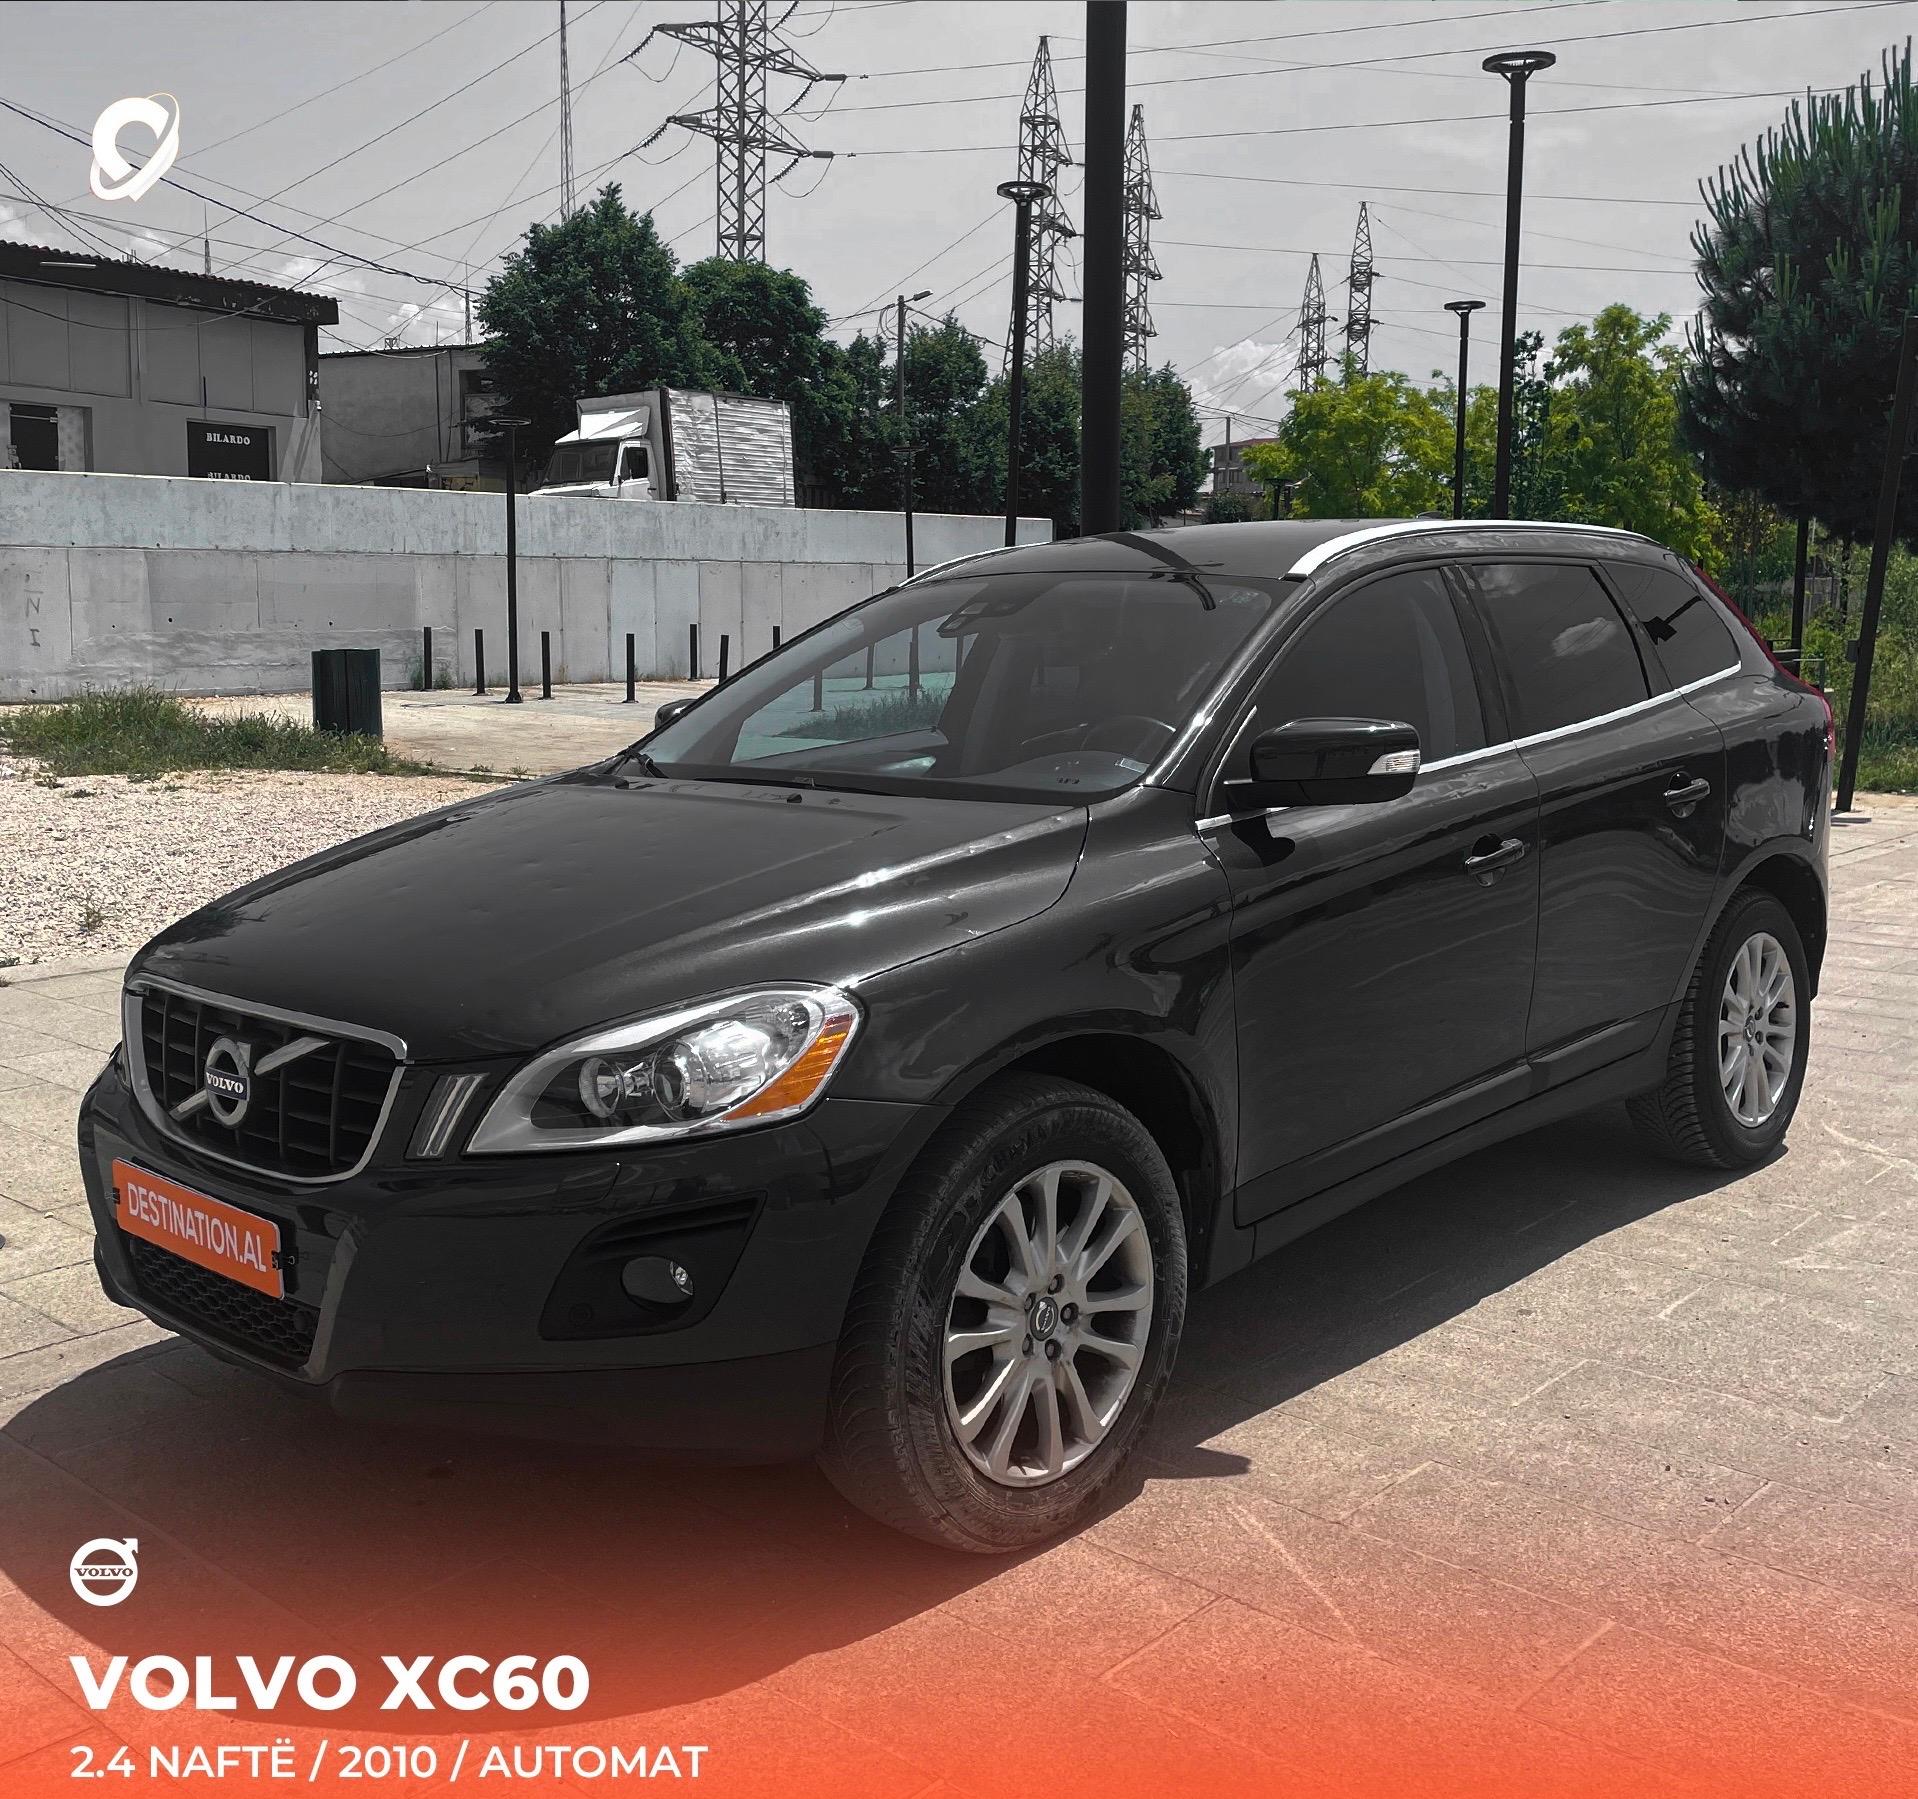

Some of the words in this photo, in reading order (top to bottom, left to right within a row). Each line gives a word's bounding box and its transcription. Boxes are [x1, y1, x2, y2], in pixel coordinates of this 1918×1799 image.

[206, 432, 251, 446] BILARDO
[205, 1071, 244, 1094] VOLVO
[127, 1182, 267, 1273] DESTINATION.AL
